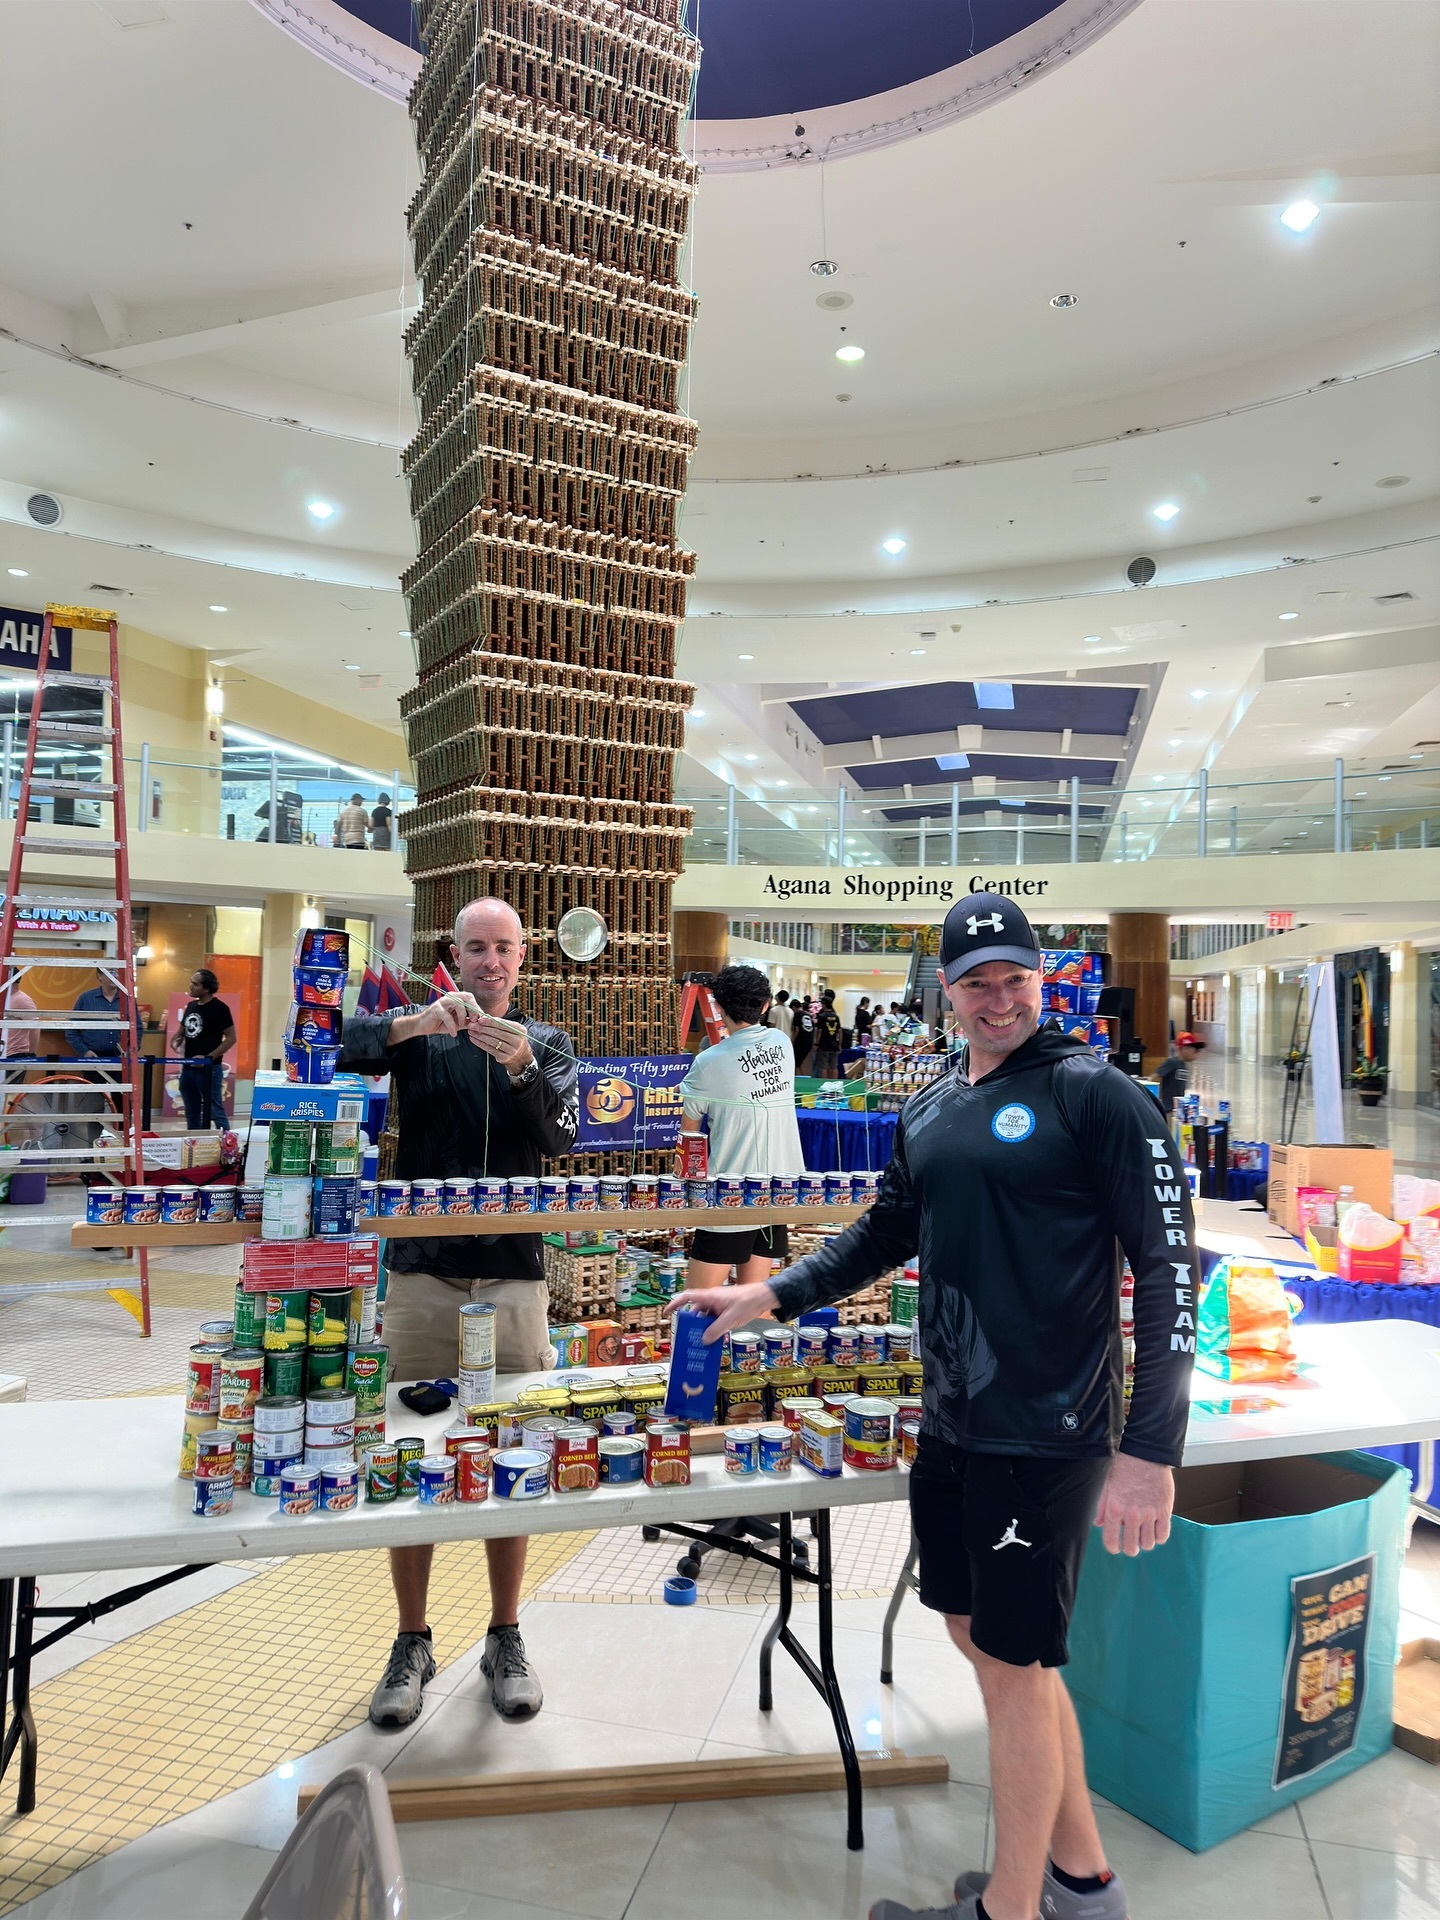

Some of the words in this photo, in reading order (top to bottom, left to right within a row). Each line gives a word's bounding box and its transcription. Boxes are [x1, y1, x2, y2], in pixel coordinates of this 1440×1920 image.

[763, 873, 831, 899] Agana
[843, 873, 954, 901] Shopping
[968, 875, 1049, 896] Center
[17, 920, 38, 929] With
[40, 921, 48, 930] A
[1270, 913, 1293, 926] EXIT
[737, 1044, 785, 1073] Heartfelt
[630, 1060, 658, 1077] Fifty
[661, 1062, 690, 1077] years
[752, 1065, 783, 1080] TOWER
[763, 1076, 780, 1087] FOR
[750, 1081, 791, 1100] HUMANITY
[298, 1101, 318, 1110] RICE
[290, 1109, 324, 1118] KRISPIES
[1004, 1113, 1025, 1121] TOWER
[651, 1121, 674, 1131] Friends
[998, 1122, 1029, 1130] HUMANITY
[1146, 1138, 1188, 1248] TOWER
[1169, 1262, 1196, 1354] TEAM
[823, 1380, 855, 1394] SPAM
[867, 1378, 899, 1390] SPAM
[729, 1389, 762, 1404] SPAM
[775, 1384, 809, 1399] SPAM
[582, 1405, 618, 1419] SPAM
[558, 1454, 583, 1462] CORNED
[583, 1453, 597, 1461] BEEF
[430, 1482, 448, 1490] VIENNA
